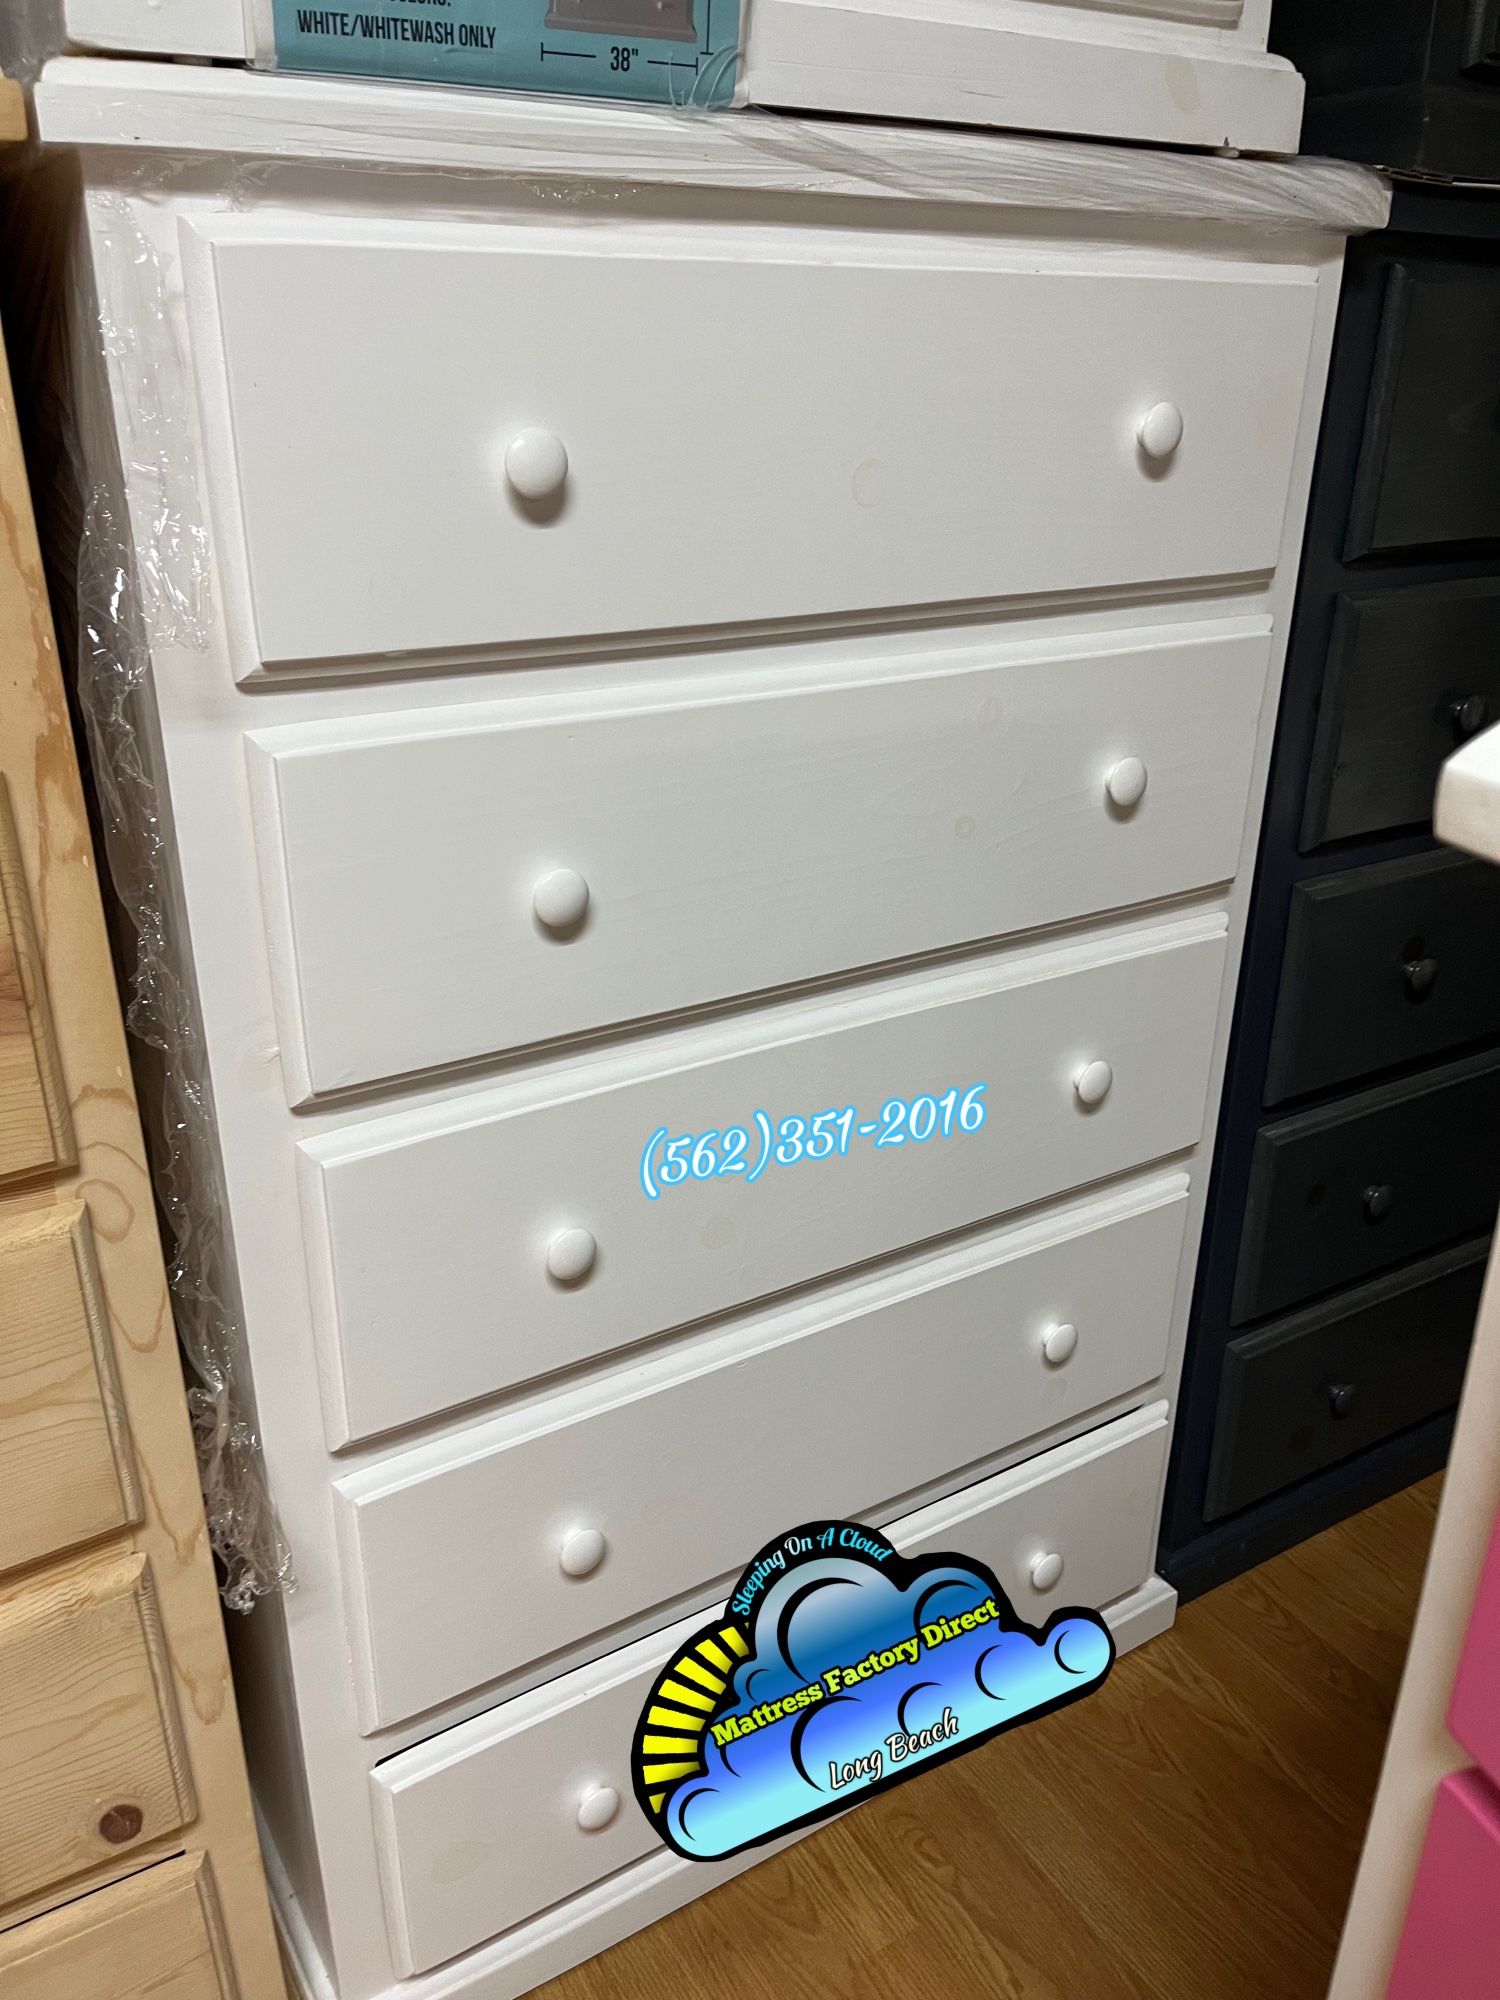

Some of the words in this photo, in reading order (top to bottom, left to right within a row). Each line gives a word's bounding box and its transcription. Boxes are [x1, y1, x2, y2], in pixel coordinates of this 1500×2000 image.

[297, 9, 454, 46] WHITE/WHITEWASH
[458, 24, 496, 49] ONLY
[610, 46, 640, 73] 38"
